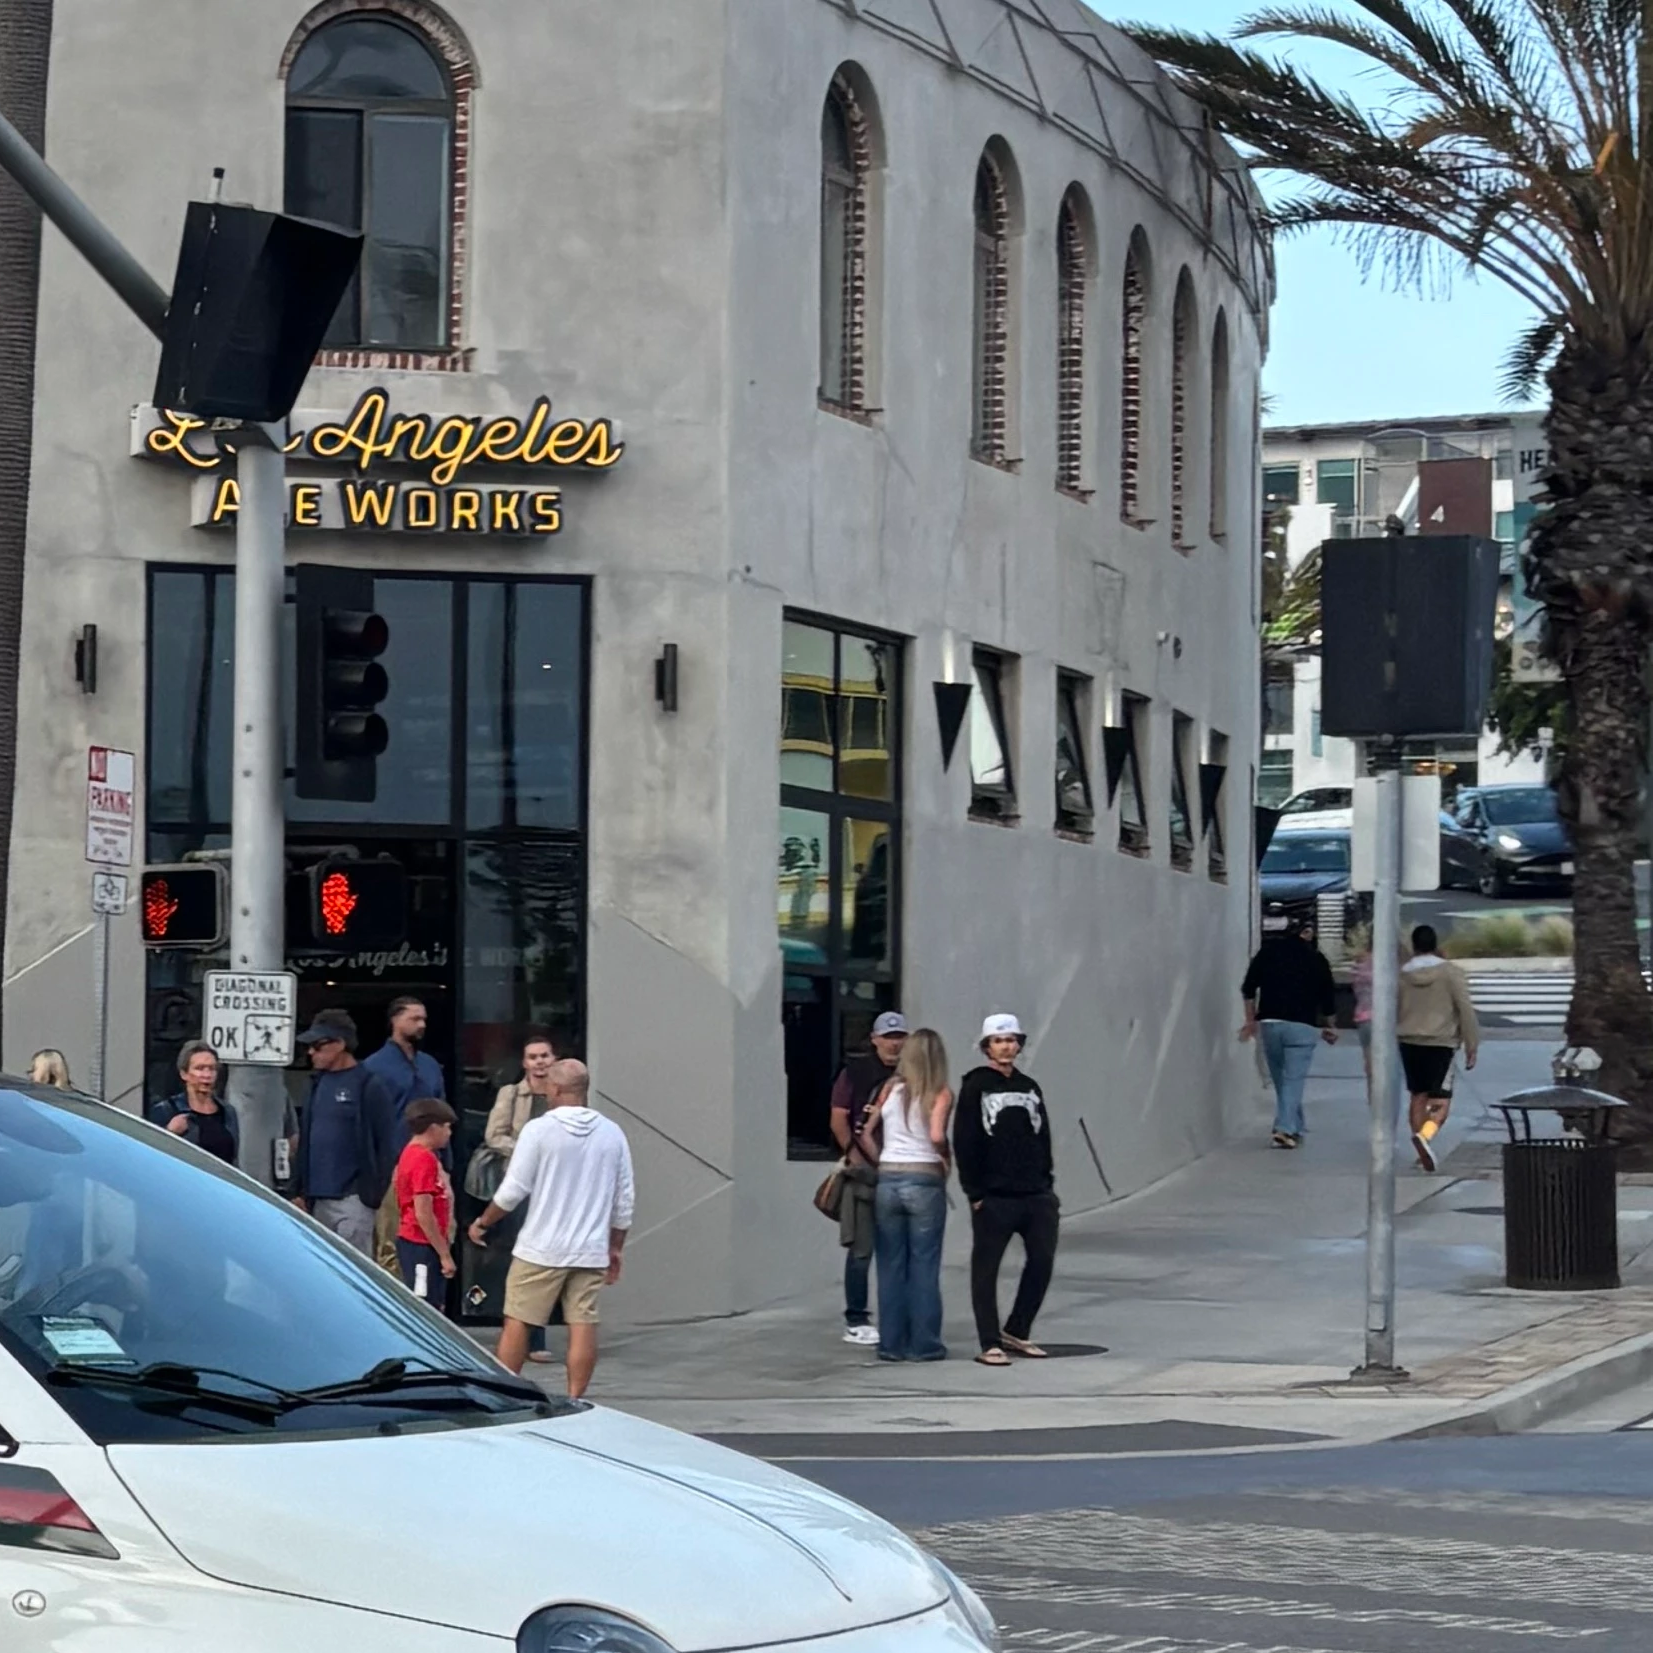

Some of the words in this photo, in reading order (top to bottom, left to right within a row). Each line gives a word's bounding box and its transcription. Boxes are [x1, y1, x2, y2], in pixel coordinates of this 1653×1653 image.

[313, 393, 624, 486] Angeles
[213, 479, 322, 525] AE
[346, 484, 562, 531] WORKS
[214, 978, 285, 994] DIAGONAL
[213, 995, 287, 1011] CROSSING
[211, 1026, 238, 1048] OK
